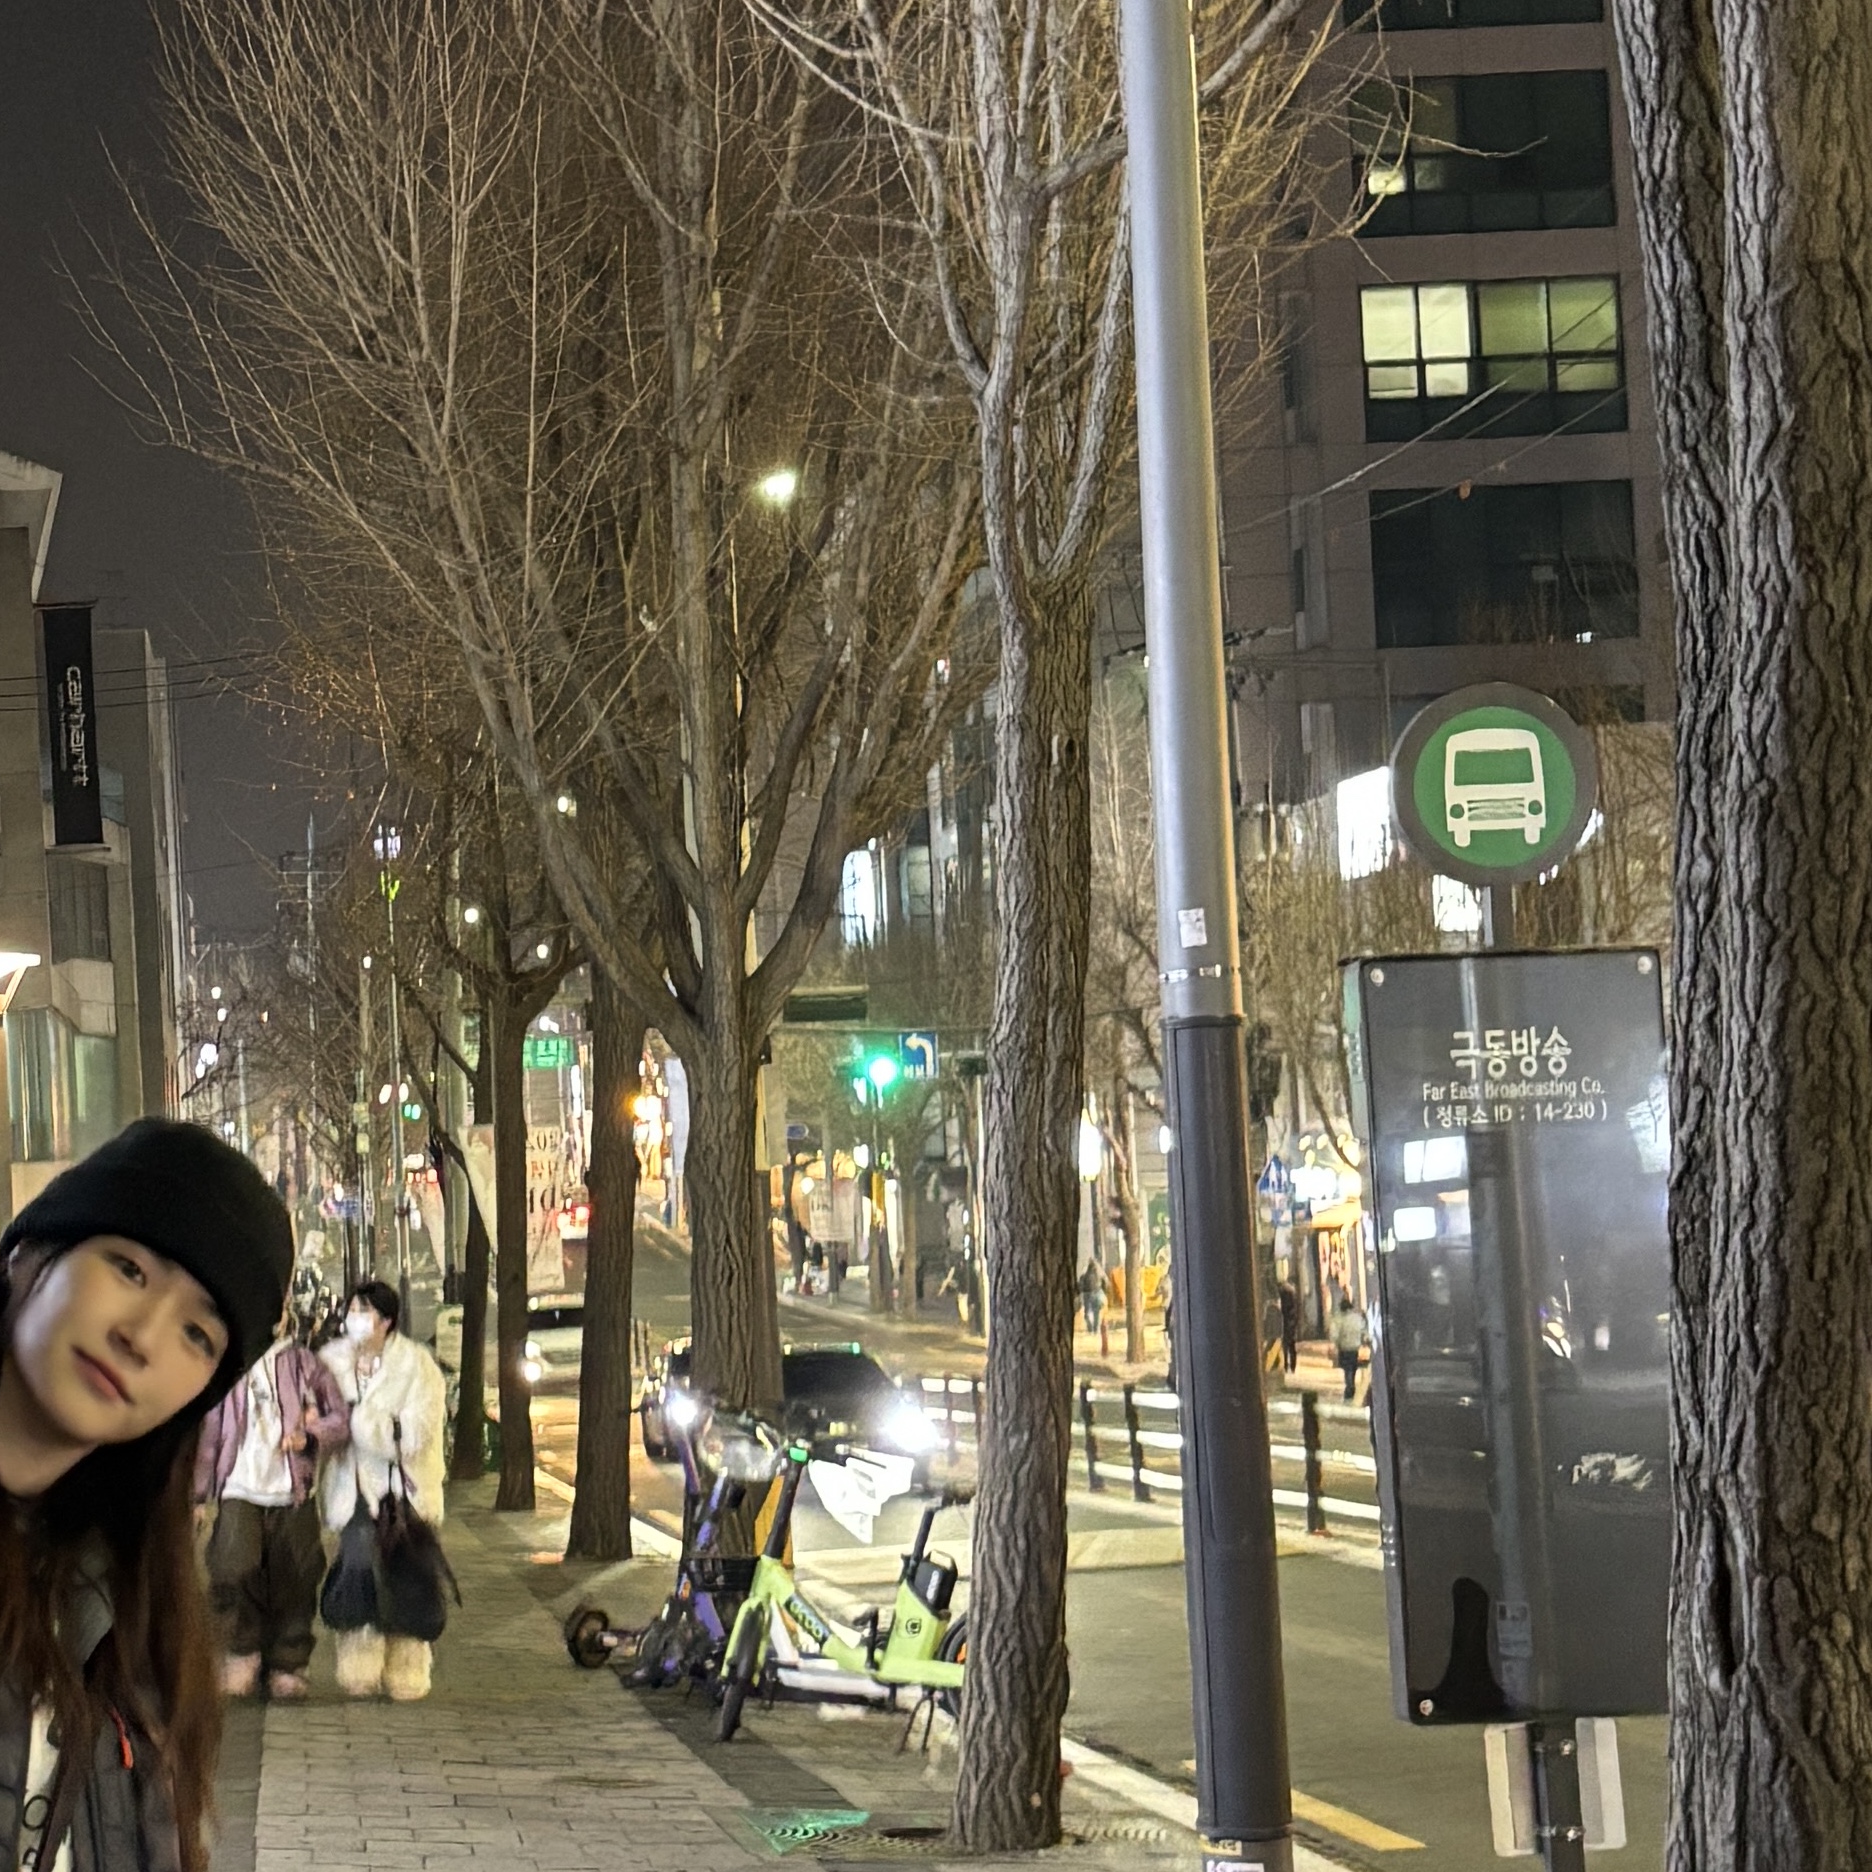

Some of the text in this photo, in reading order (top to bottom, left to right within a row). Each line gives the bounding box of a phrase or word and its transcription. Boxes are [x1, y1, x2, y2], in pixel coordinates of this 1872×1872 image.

[67, 666, 89, 787] carhartt
[1449, 1025, 1573, 1080] 극동방송
[1422, 1075, 1606, 1101] Far East Broadcasting Co.
[1494, 1104, 1513, 1123] ID
[1535, 1101, 1595, 1122] 14-230
